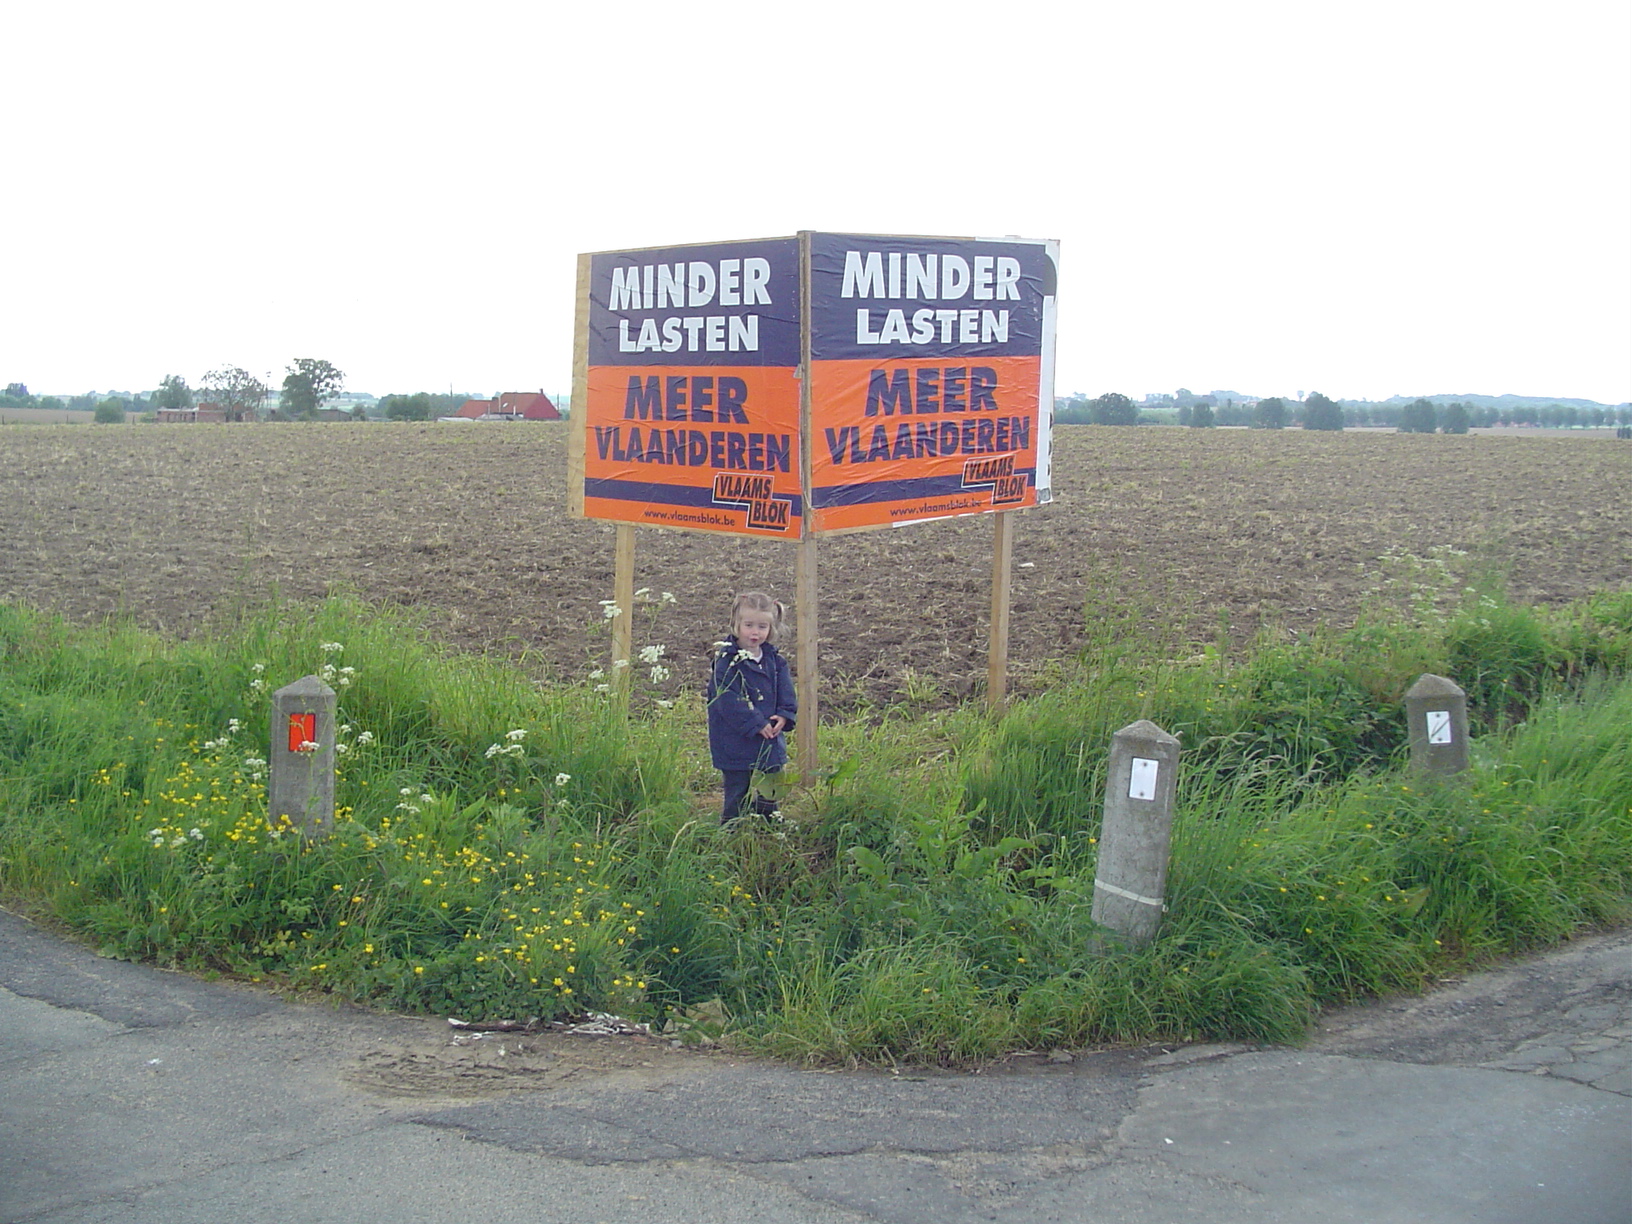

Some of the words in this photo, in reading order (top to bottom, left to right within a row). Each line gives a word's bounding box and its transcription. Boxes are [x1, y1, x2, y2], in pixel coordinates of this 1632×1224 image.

[608, 257, 772, 310] MINDER
[841, 251, 1021, 300] MINDER
[619, 315, 759, 352] LASTEN
[857, 309, 1009, 344] LASTEN
[624, 375, 750, 424] MEER
[865, 367, 998, 417] MEER
[595, 426, 790, 473] VLAANDEREN
[825, 416, 1030, 465] VLAANDEREN
[969, 457, 1014, 480] VLAAMS
[999, 476, 1026, 497] BLOK
[718, 476, 771, 499] VLAAMS
[644, 510, 736, 527] www.vlaamsblok.be
[752, 502, 788, 524] BLOK
[890, 499, 982, 517] www.vlaamsblok.be
